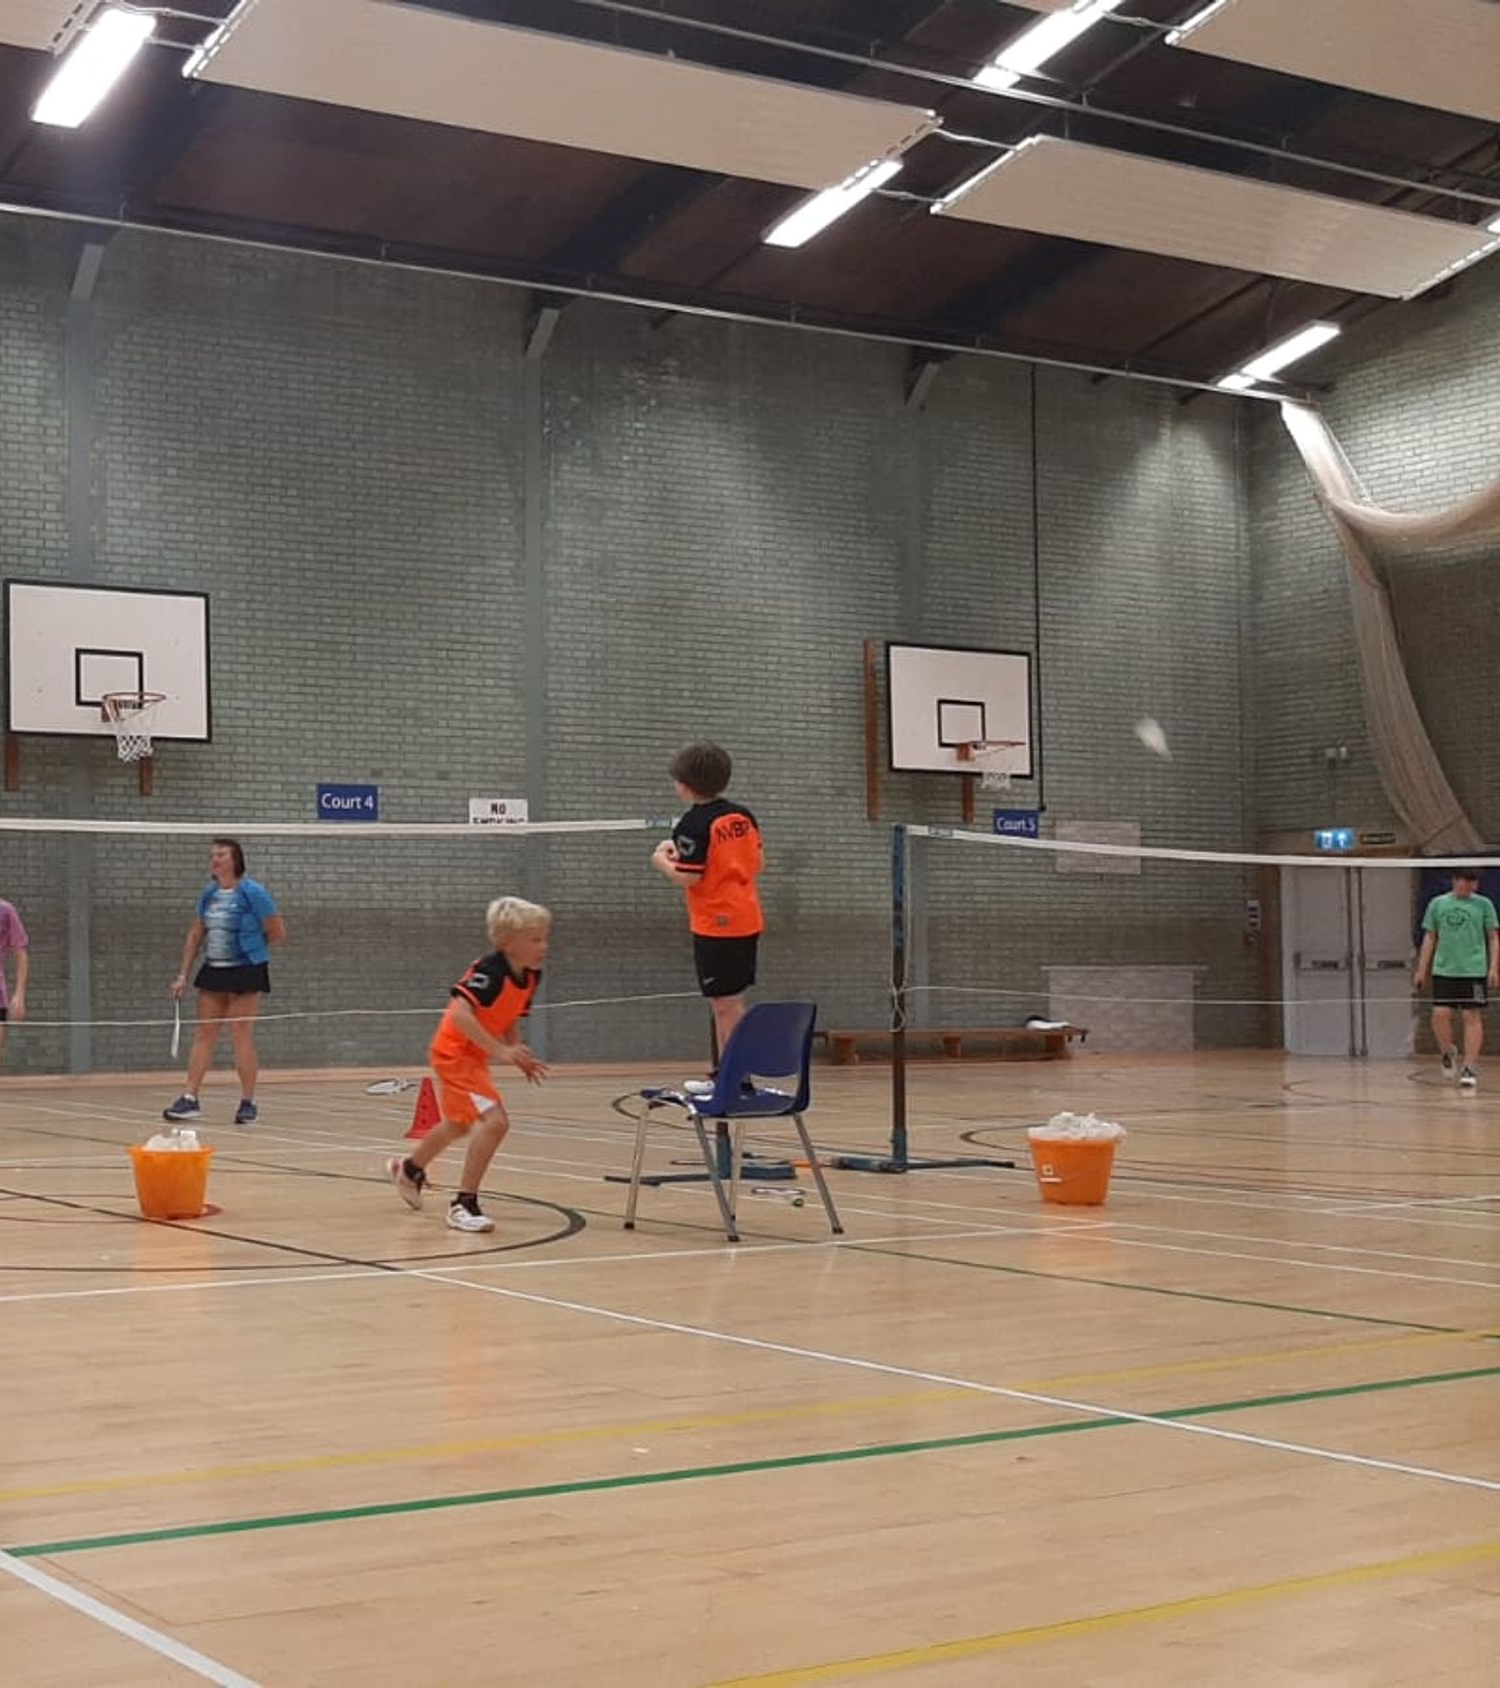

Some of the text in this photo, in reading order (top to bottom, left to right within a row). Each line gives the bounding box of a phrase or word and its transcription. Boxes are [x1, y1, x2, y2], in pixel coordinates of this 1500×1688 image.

[321, 793, 374, 811] Court 4
[491, 802, 506, 815] NO
[996, 817, 1026, 831] Court
